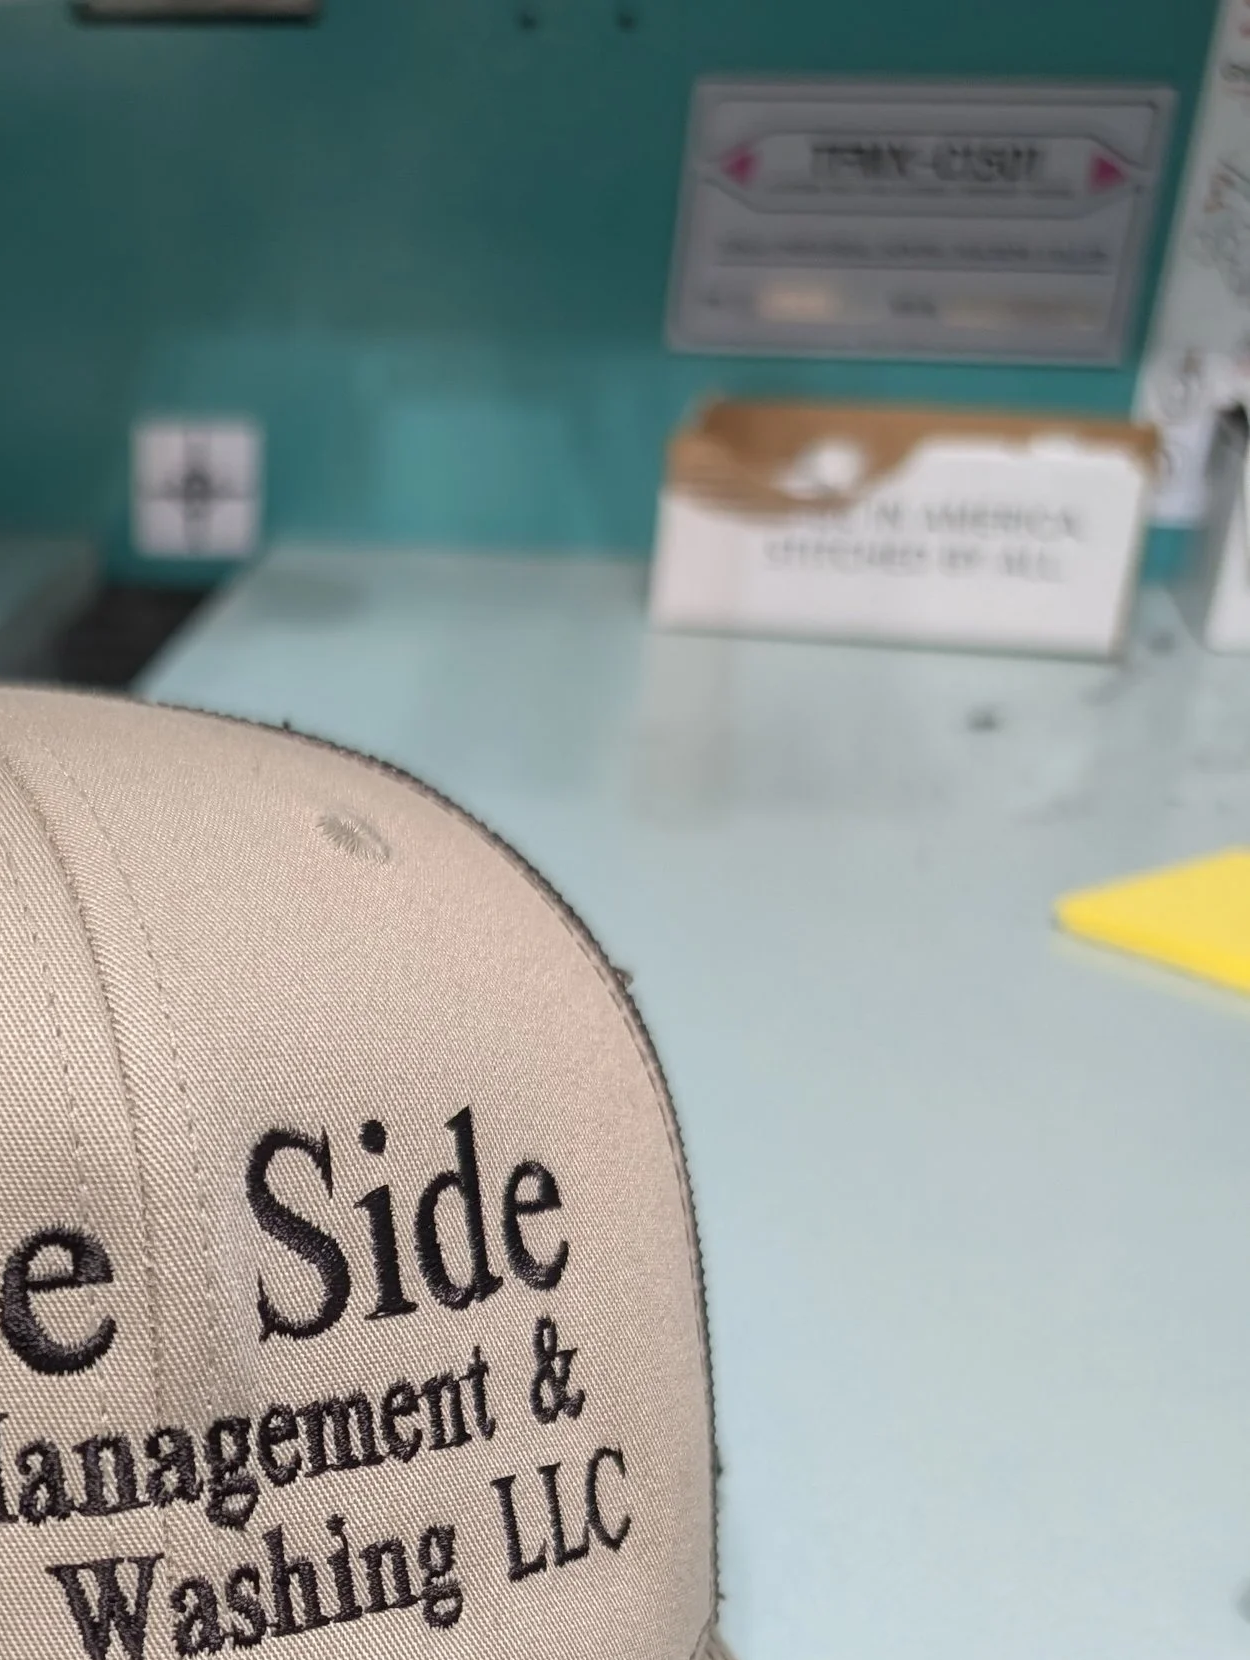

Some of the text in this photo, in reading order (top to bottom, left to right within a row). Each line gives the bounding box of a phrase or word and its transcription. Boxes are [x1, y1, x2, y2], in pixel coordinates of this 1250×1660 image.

[245, 1106, 568, 1342] Side
[529, 1318, 584, 1425] &
[490, 1447, 631, 1582] LLC
